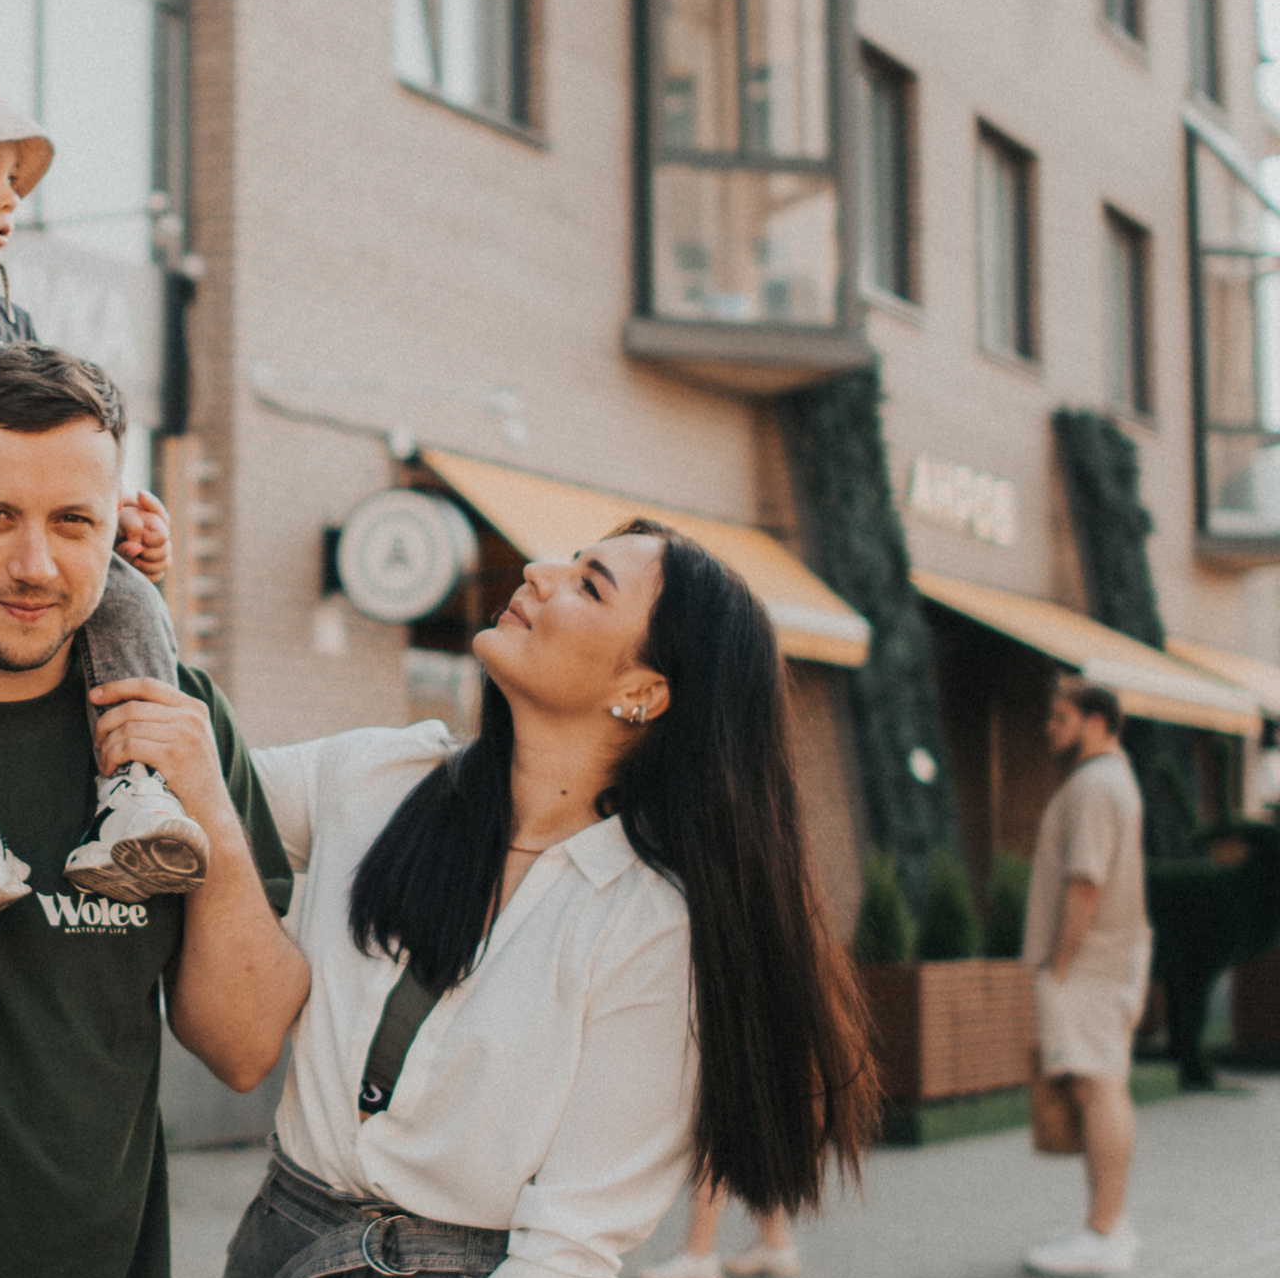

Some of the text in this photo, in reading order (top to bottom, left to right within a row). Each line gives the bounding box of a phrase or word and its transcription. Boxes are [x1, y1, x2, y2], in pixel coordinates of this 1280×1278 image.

[36, 892, 148, 927] Wolee
[64, 926, 128, 935] MASTER OF LIFE
